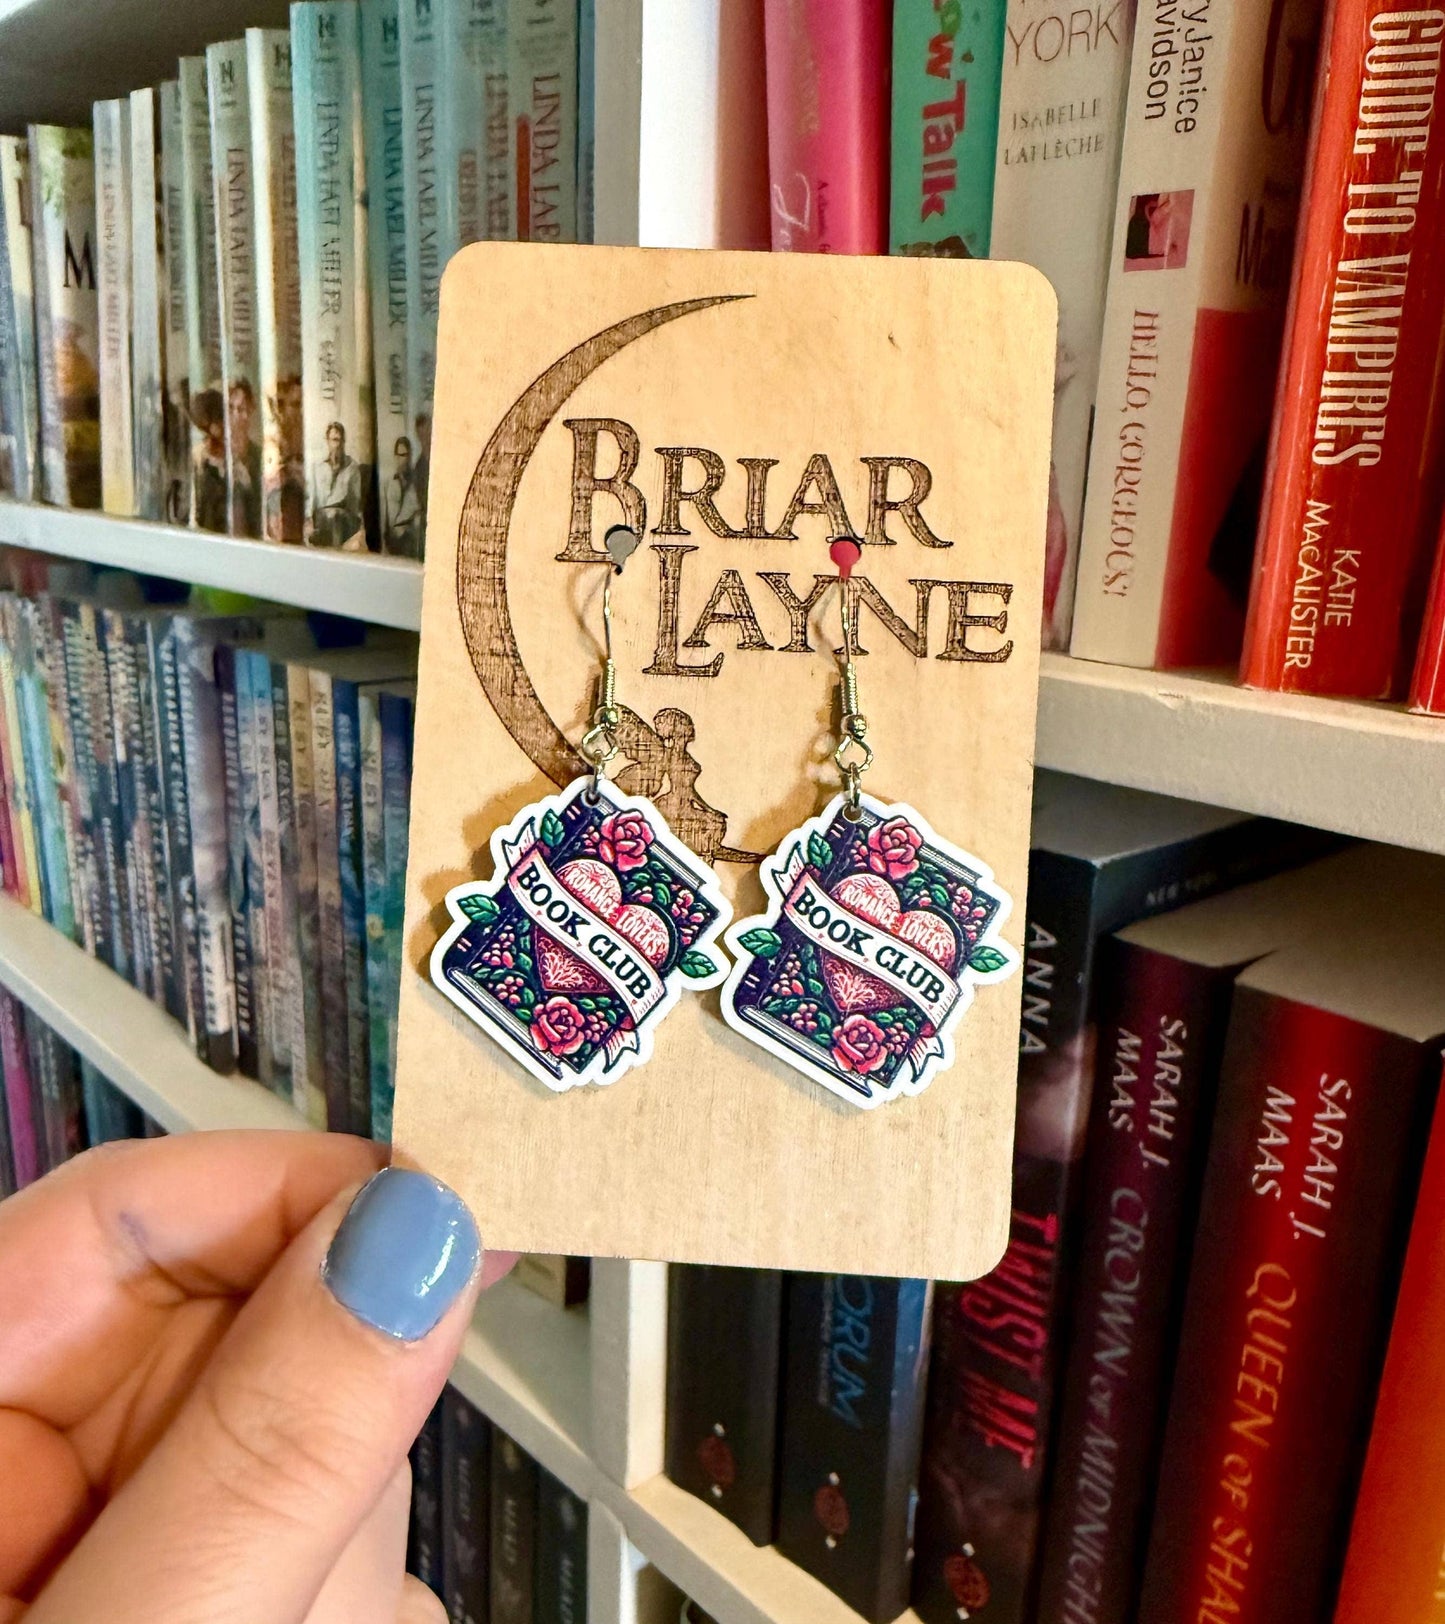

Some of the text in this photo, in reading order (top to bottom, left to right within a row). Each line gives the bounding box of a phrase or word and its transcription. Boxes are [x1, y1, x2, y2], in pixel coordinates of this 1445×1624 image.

[1007, 0, 1120, 66] YORK
[1175, 0, 1214, 133] yJanice
[414, 83, 434, 160] LINDA
[533, 72, 561, 240] LINDA LAE
[921, 0, 966, 224] ow Talk
[1312, 9, 1445, 467] GUIDE TO VAMPIRES
[555, 417, 955, 564] BRIAR
[1103, 309, 1159, 598] HELLO, GORGEOUS!
[642, 545, 1015, 679] LAYNE
[1285, 499, 1331, 669] MACALISTER
[1324, 549, 1362, 628] KATIE
[517, 861, 652, 1000] BOOK CLUB
[565, 867, 661, 957] ROMANCE LOVERS
[792, 886, 946, 1005] BOOK CLUB
[840, 882, 947, 962] ROMANCE LOVERS
[1020, 920, 1058, 1055] ANNA
[1108, 1026, 1143, 1133] MAAS
[1137, 1014, 1188, 1170] SARAH J.
[1250, 1084, 1298, 1202] MAAS
[1287, 1071, 1353, 1241] SARAH J.
[829, 1276, 874, 1430] ORUM
[958, 1211, 1060, 1381] TWIST
[1093, 1186, 1149, 1378] CROWN
[1229, 1261, 1297, 1450] QUEEN
[1063, 1422, 1120, 1624] MIDNIGH
